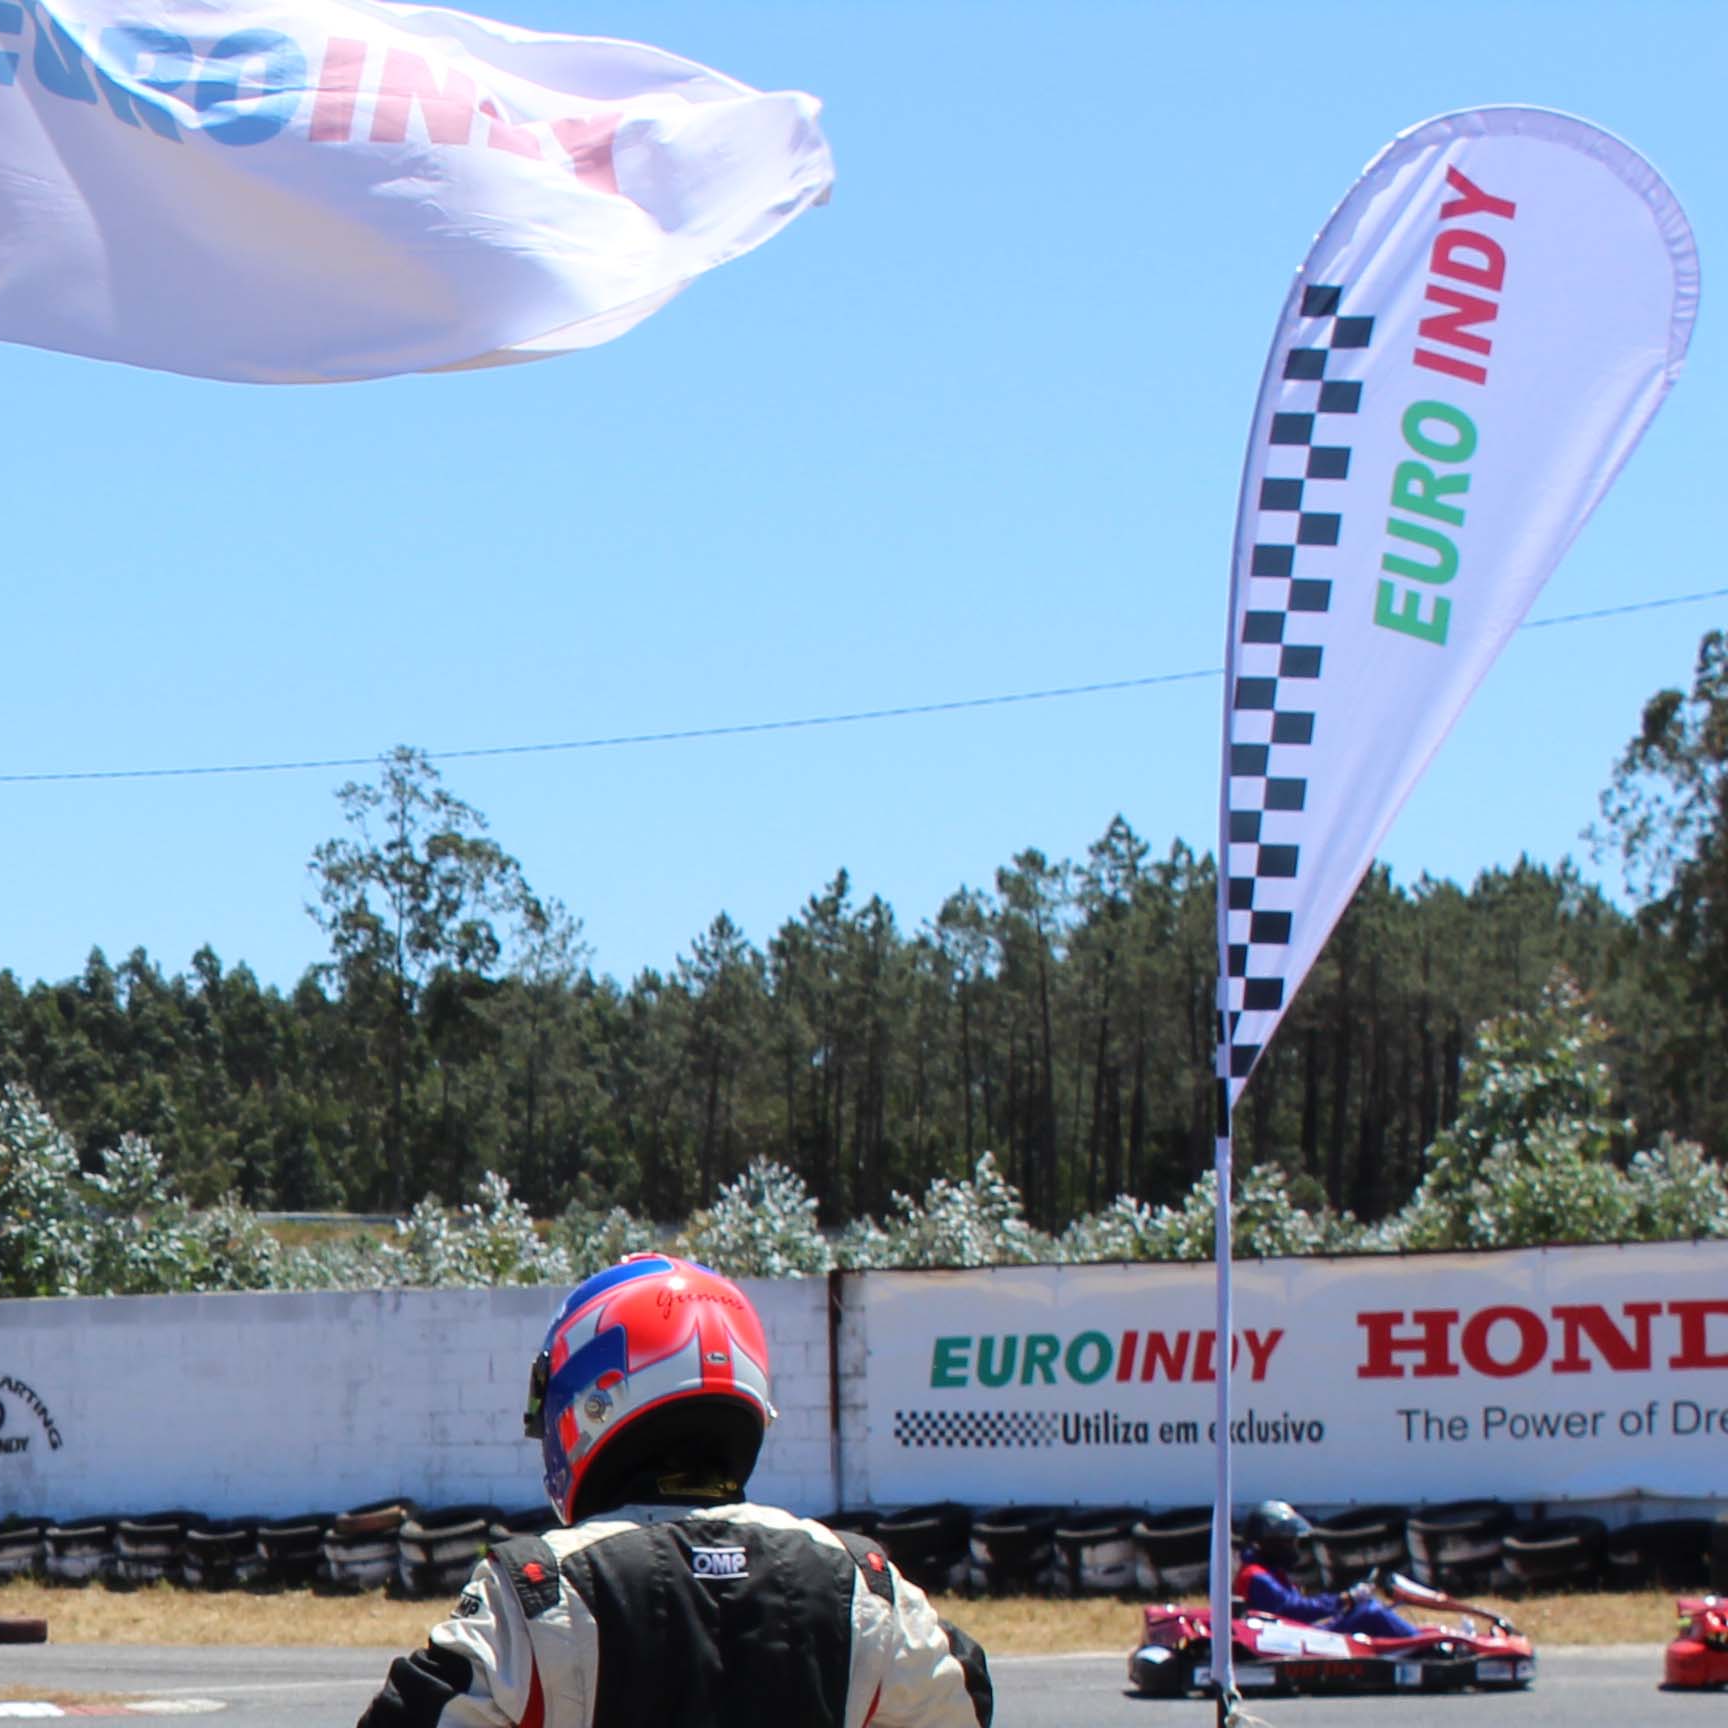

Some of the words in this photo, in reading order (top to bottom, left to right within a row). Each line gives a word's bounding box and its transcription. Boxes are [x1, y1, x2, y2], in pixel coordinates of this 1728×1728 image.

[1411, 163, 1518, 386] INDY
[1373, 399, 1479, 647] EURO
[929, 1328, 1285, 1389] EUROINDY
[1061, 1410, 1150, 1446] Utiliza
[1158, 1418, 1200, 1445] em
[1397, 1408, 1470, 1443] The
[1483, 1405, 1606, 1440] Power
[1618, 1399, 1659, 1437] of
[692, 1552, 747, 1574] OMP
